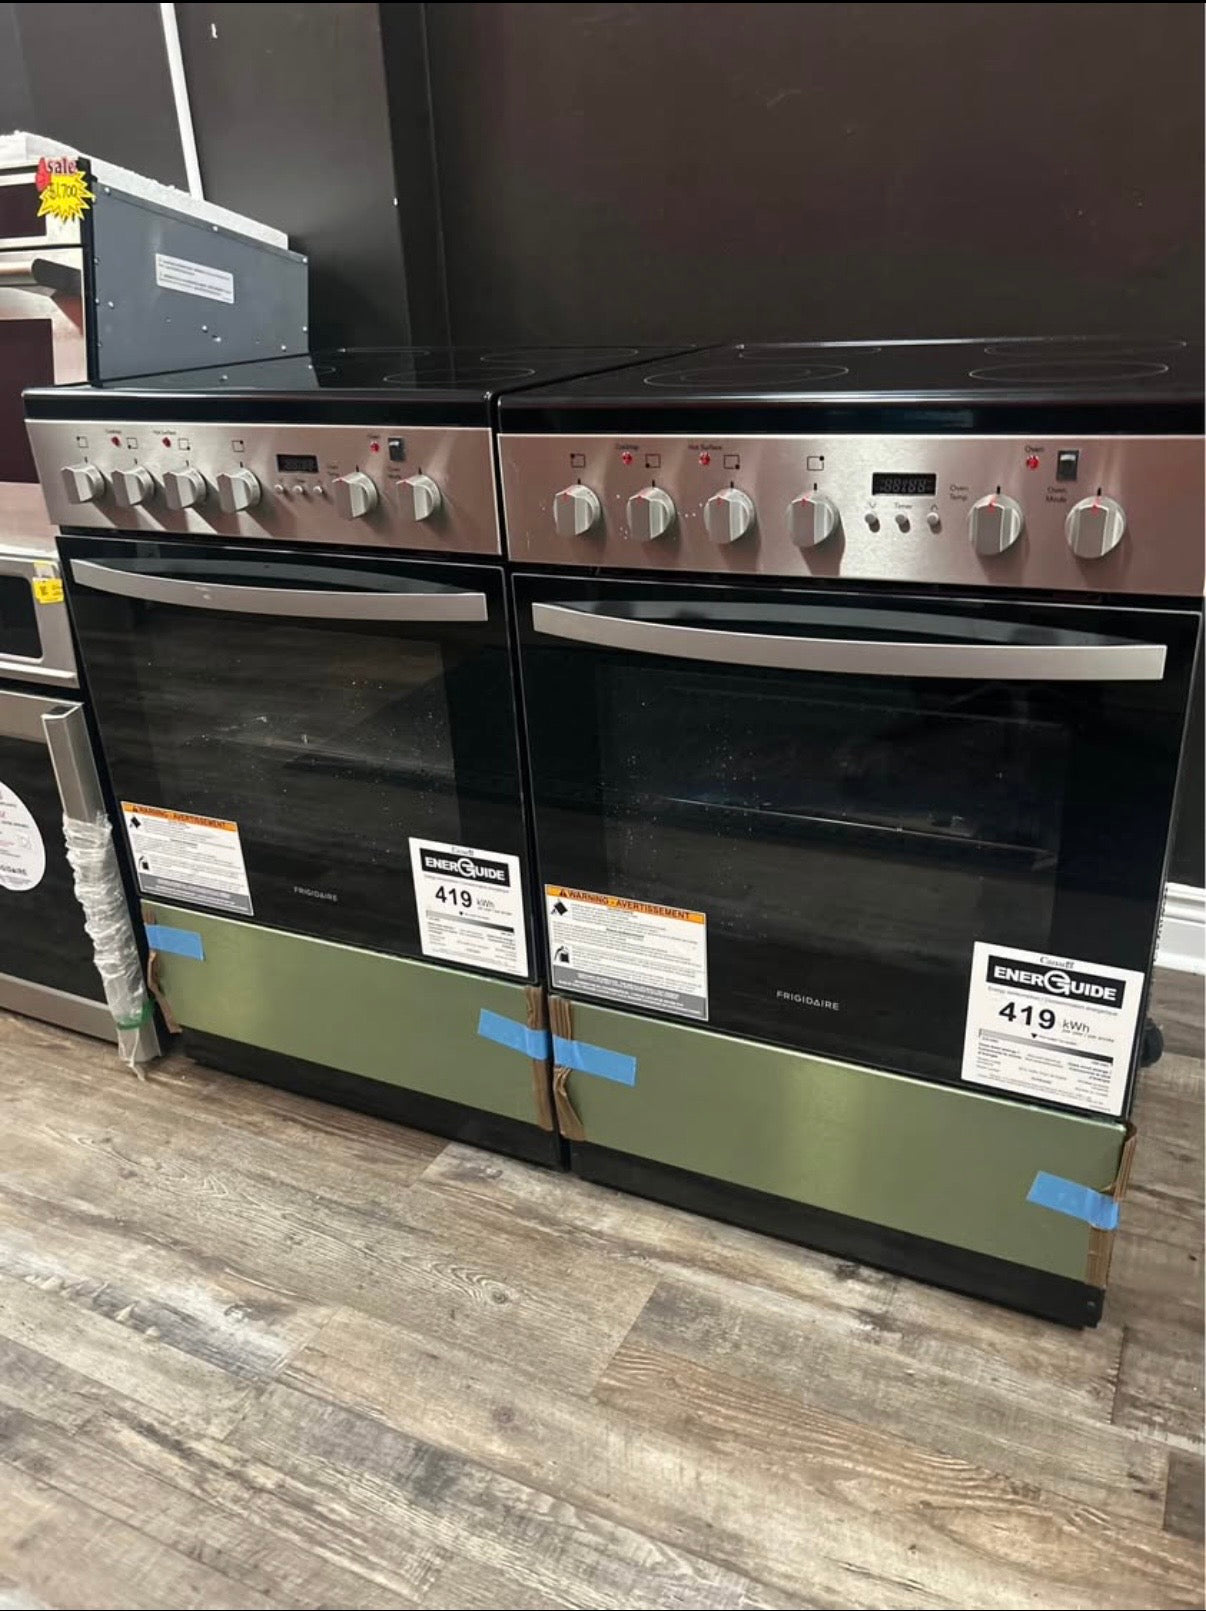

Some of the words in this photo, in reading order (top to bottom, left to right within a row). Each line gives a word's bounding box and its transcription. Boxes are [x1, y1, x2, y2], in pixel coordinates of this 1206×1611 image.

[48, 157, 77, 174] sale
[424, 856, 506, 881] ENERGUIDE
[435, 885, 473, 908] 419
[568, 889, 609, 906] WARNING
[616, 900, 690, 921] AVERTISSEMENT
[993, 965, 1118, 1002] ENERGUIDE
[776, 989, 840, 1011] FRIGIDAIRE
[998, 1001, 1057, 1030] 419
[1062, 1018, 1091, 1034] kWh
